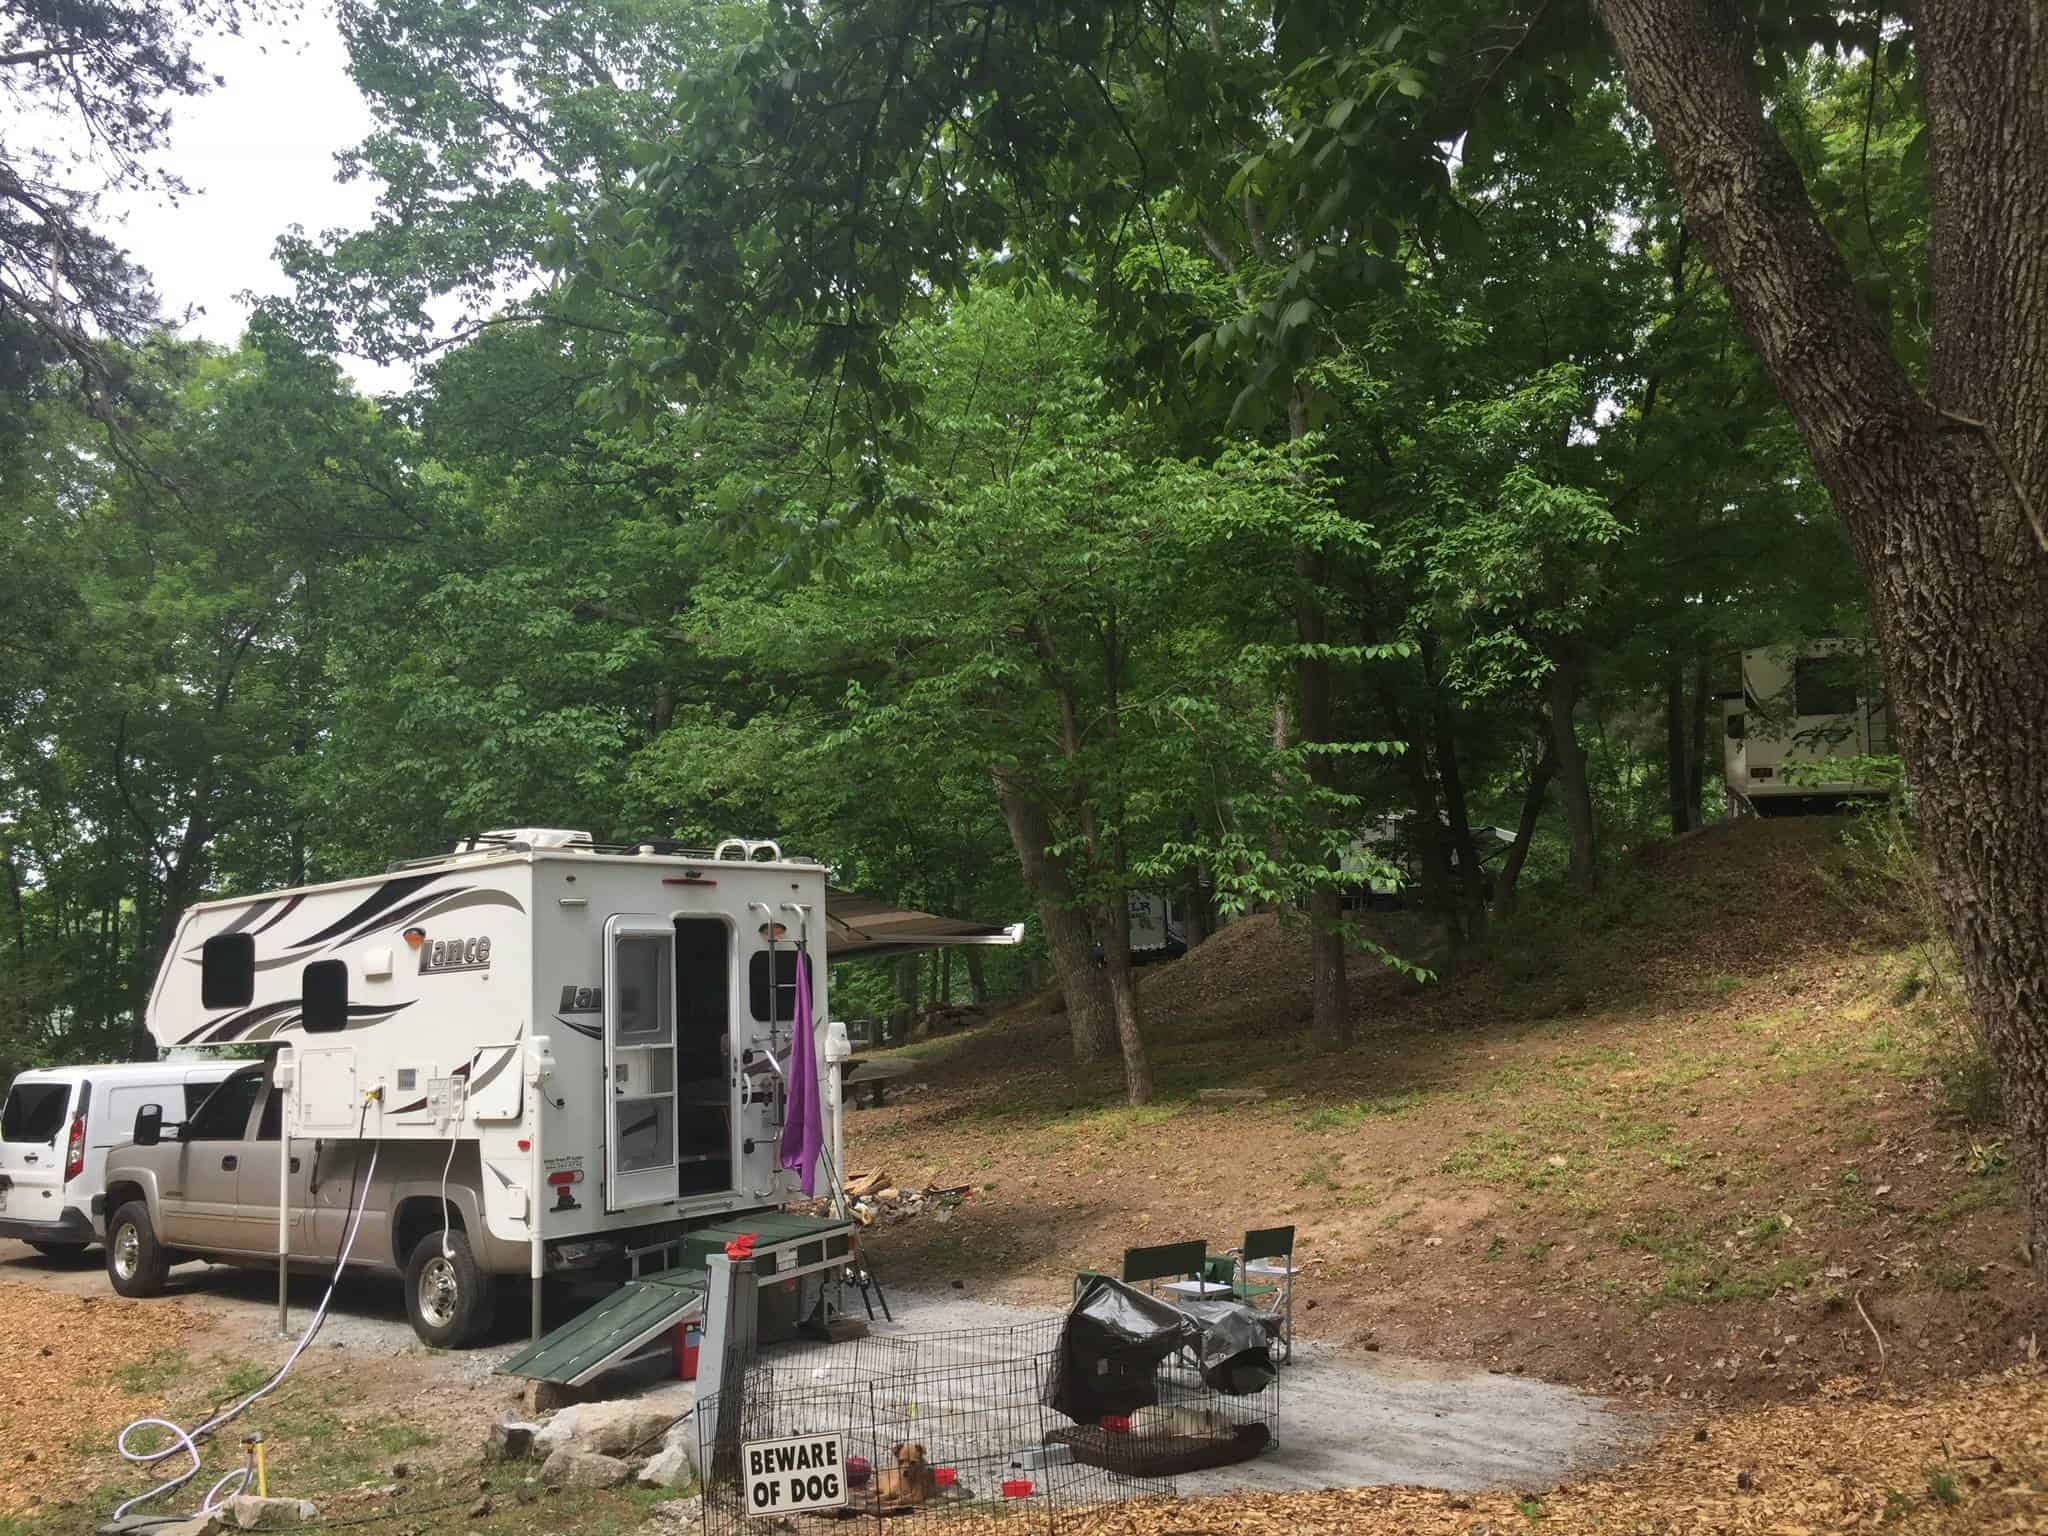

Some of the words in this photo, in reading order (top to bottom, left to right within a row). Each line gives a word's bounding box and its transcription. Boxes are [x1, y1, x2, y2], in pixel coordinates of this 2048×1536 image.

[750, 1441, 838, 1475] BEWARE
[753, 1481, 780, 1508] OF
[791, 1473, 839, 1503] DOG
